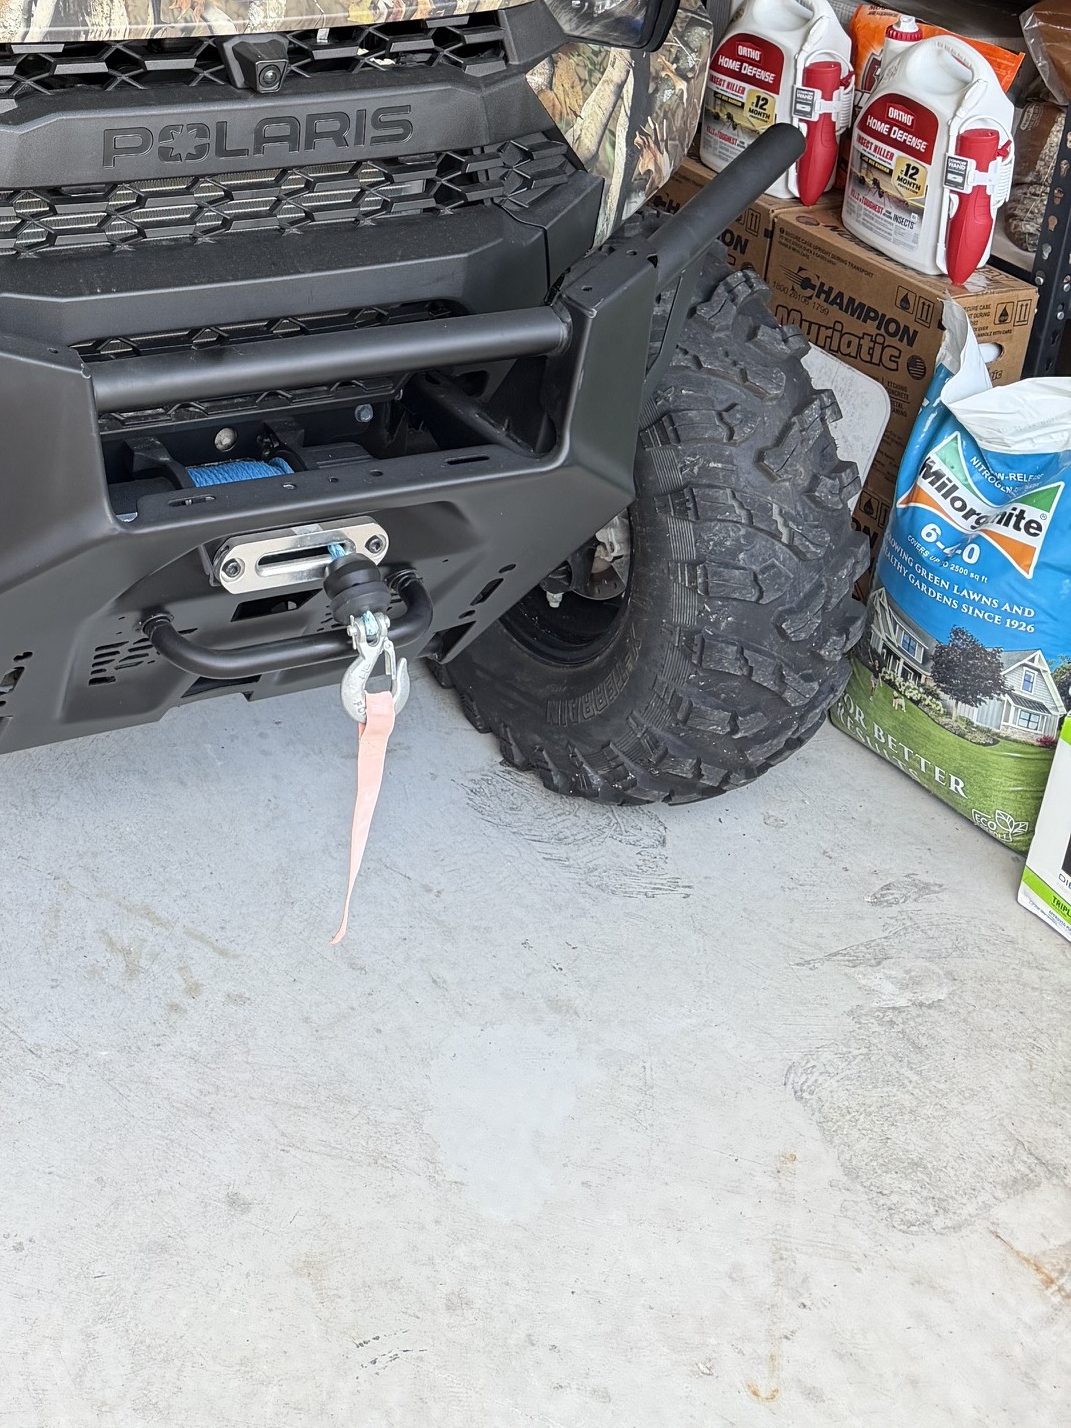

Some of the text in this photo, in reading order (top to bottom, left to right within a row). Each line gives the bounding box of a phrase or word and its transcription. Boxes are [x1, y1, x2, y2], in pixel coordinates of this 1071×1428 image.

[737, 45, 761, 61] ORTHO
[718, 55, 776, 84] HOME DEFENSE
[727, 80, 746, 95] KILLER
[797, 92, 814, 100] WAND
[755, 95, 770, 111] 12
[748, 108, 771, 120] MONTH
[888, 106, 914, 126] ORTHO
[102, 104, 414, 169] POLARIS
[866, 115, 929, 153] HOME DEFENSE
[873, 143, 895, 161] KILLER
[903, 162, 920, 181] 12
[948, 161, 966, 170] WAND
[896, 175, 921, 191] MONTH
[893, 215, 915, 230] INSECTS
[831, 252, 849, 265] DURING
[848, 261, 874, 278] TRANSPORT
[795, 266, 919, 348] CHAMPION
[776, 304, 902, 372] Muriatic
[886, 387, 910, 401] ONCRETE
[907, 534, 930, 557] COVERS
[929, 553, 940, 563] UP
[950, 563, 969, 576] 2500
[970, 573, 980, 581] sq
[981, 575, 988, 584] ft
[915, 560, 950, 590] GREEN
[953, 584, 999, 609] LAWNS
[1001, 602, 1035, 618] AND
[908, 574, 959, 609] GARDENS
[961, 602, 1002, 625] SINCE
[1005, 618, 1035, 634] 1926
[872, 722, 969, 800] BETTER
[974, 813, 997, 832] ECO
